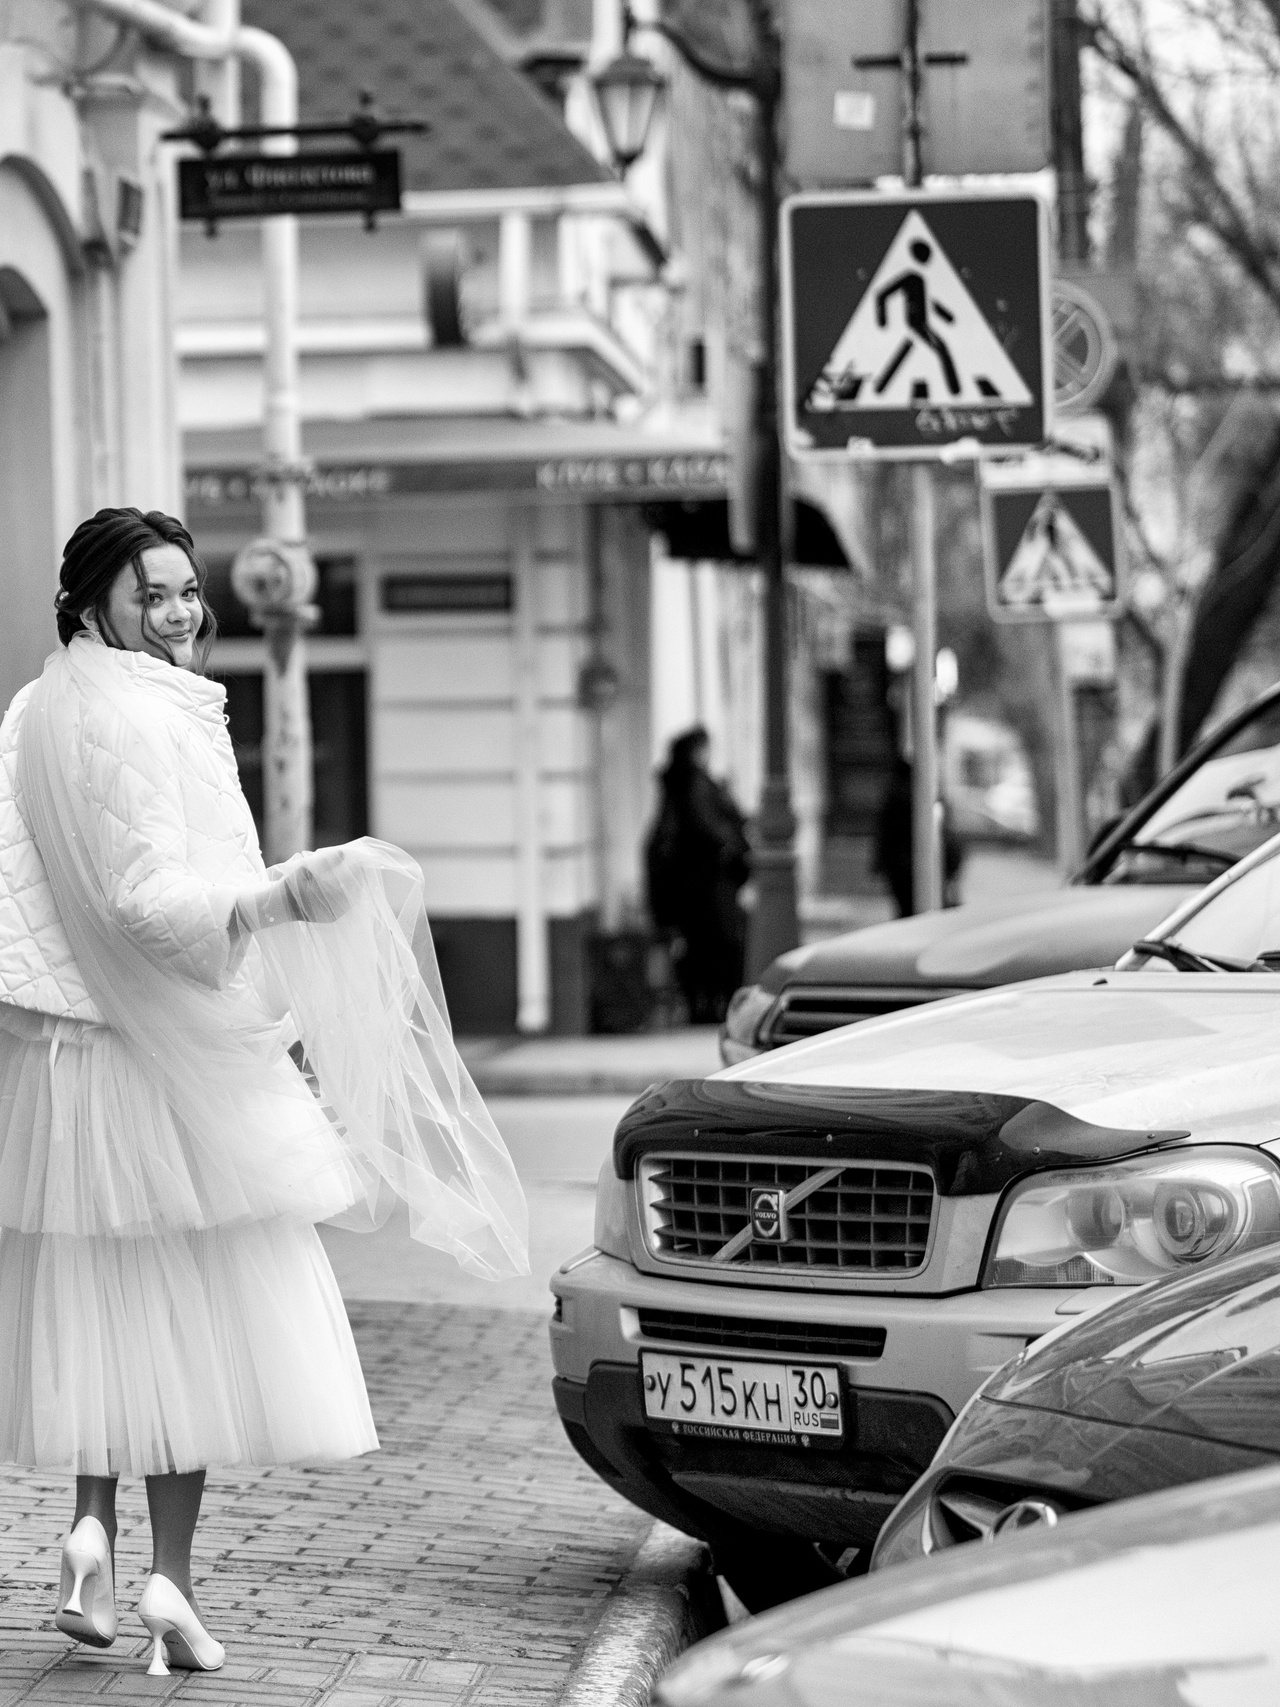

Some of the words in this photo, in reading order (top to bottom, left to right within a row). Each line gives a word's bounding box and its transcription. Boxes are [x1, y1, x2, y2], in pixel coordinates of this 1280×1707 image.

[755, 1211, 777, 1219] VOLVO
[792, 1369, 827, 1409] 30
[793, 1411, 820, 1427] RUS
[682, 1423, 740, 1440] РОССИЙСКАЯ
[742, 1429, 797, 1444] ФЕДЕРАЦИЯ
